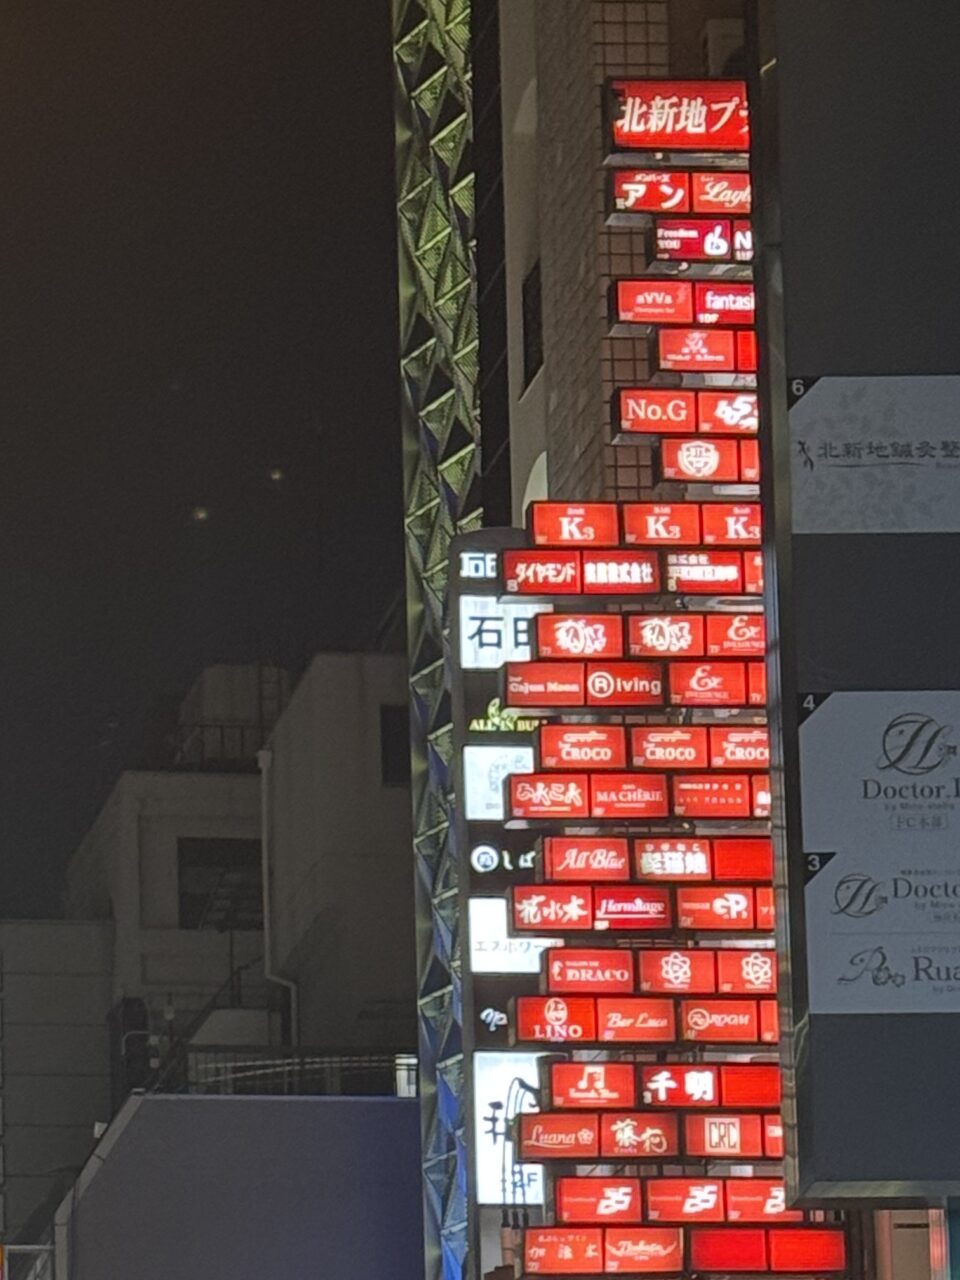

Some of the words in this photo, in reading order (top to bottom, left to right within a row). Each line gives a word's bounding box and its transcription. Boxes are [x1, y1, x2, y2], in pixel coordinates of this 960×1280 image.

[792, 379, 805, 396] 6
[626, 400, 688, 421] No.G
[803, 694, 815, 711] 4
[561, 748, 612, 761] CROCO
[646, 747, 696, 761] CROCO
[807, 855, 821, 872] 3
[566, 968, 629, 982] DRACO
[534, 1026, 583, 1039] LINO
